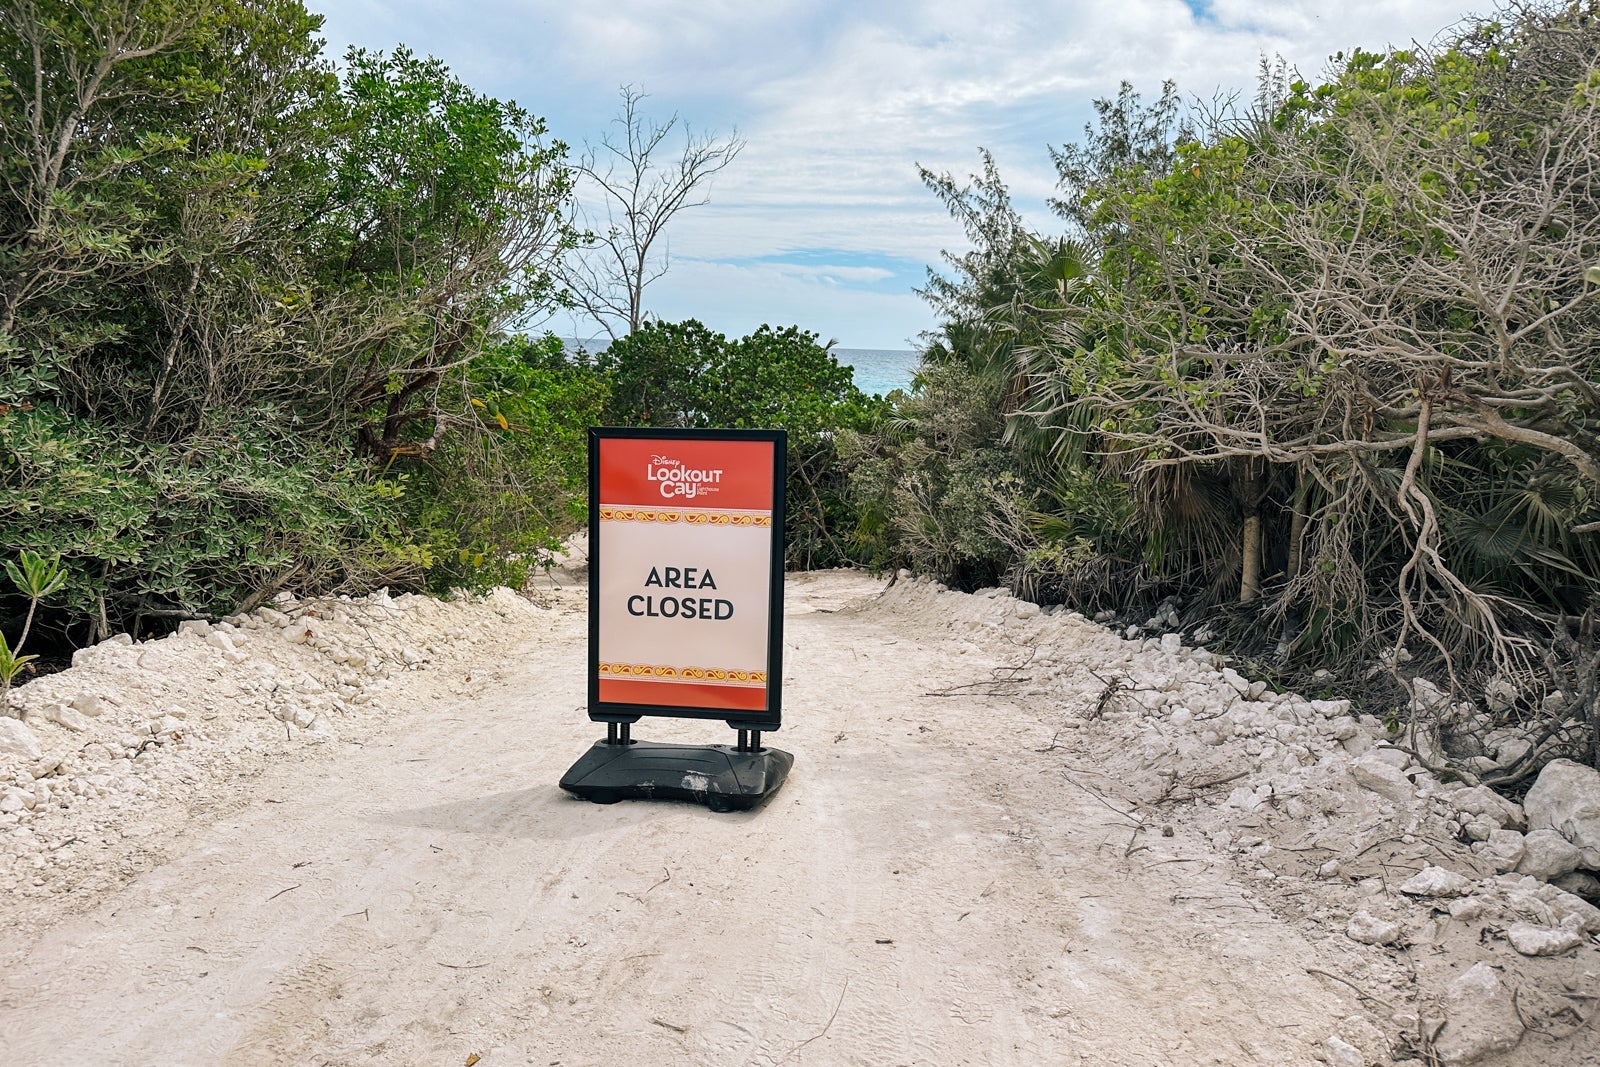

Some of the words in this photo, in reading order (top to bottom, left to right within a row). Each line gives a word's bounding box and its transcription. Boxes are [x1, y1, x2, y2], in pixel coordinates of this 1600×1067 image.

[651, 454, 680, 468] Disney
[647, 463, 723, 483] Lookout
[660, 480, 697, 499] Cay
[644, 566, 717, 590] AREA
[627, 594, 734, 620] CLOSED
